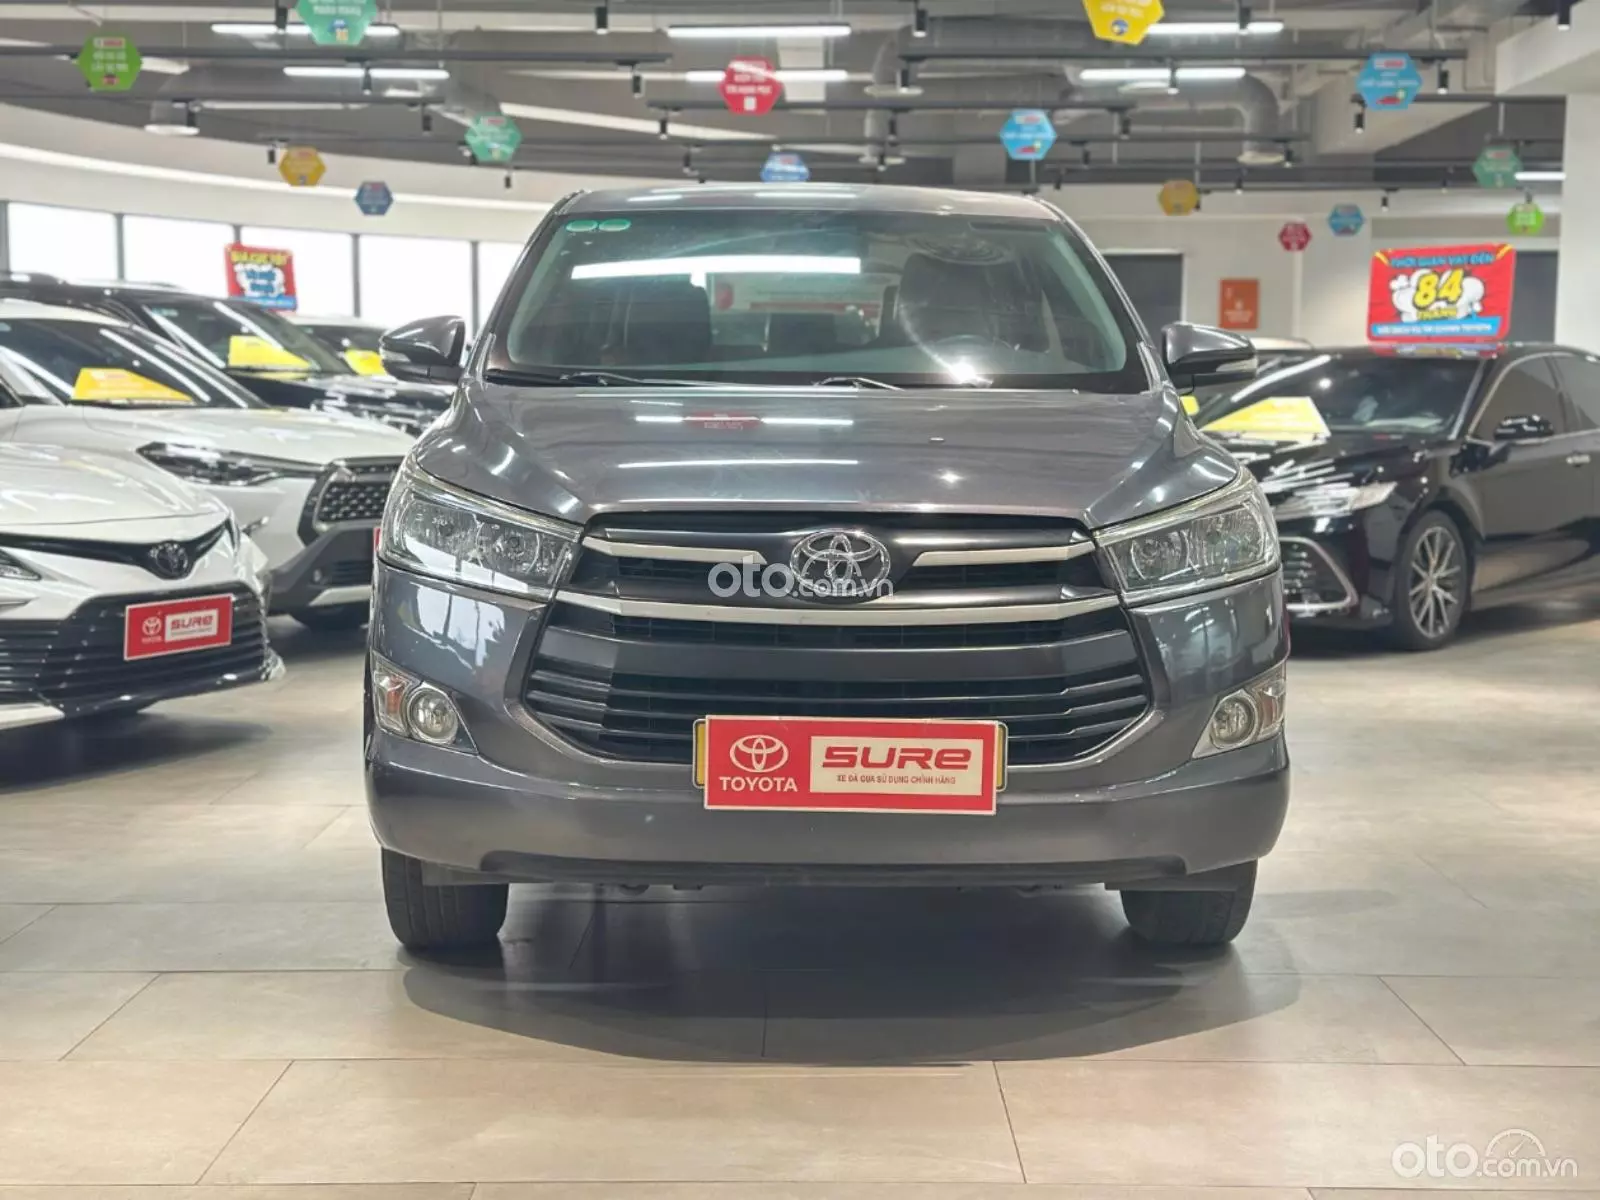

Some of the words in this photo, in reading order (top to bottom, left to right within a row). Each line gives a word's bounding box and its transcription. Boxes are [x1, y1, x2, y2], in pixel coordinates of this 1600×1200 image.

[1413, 268, 1464, 309] 84
[719, 776, 798, 792] TOYOTA
[837, 774, 847, 783] XE
